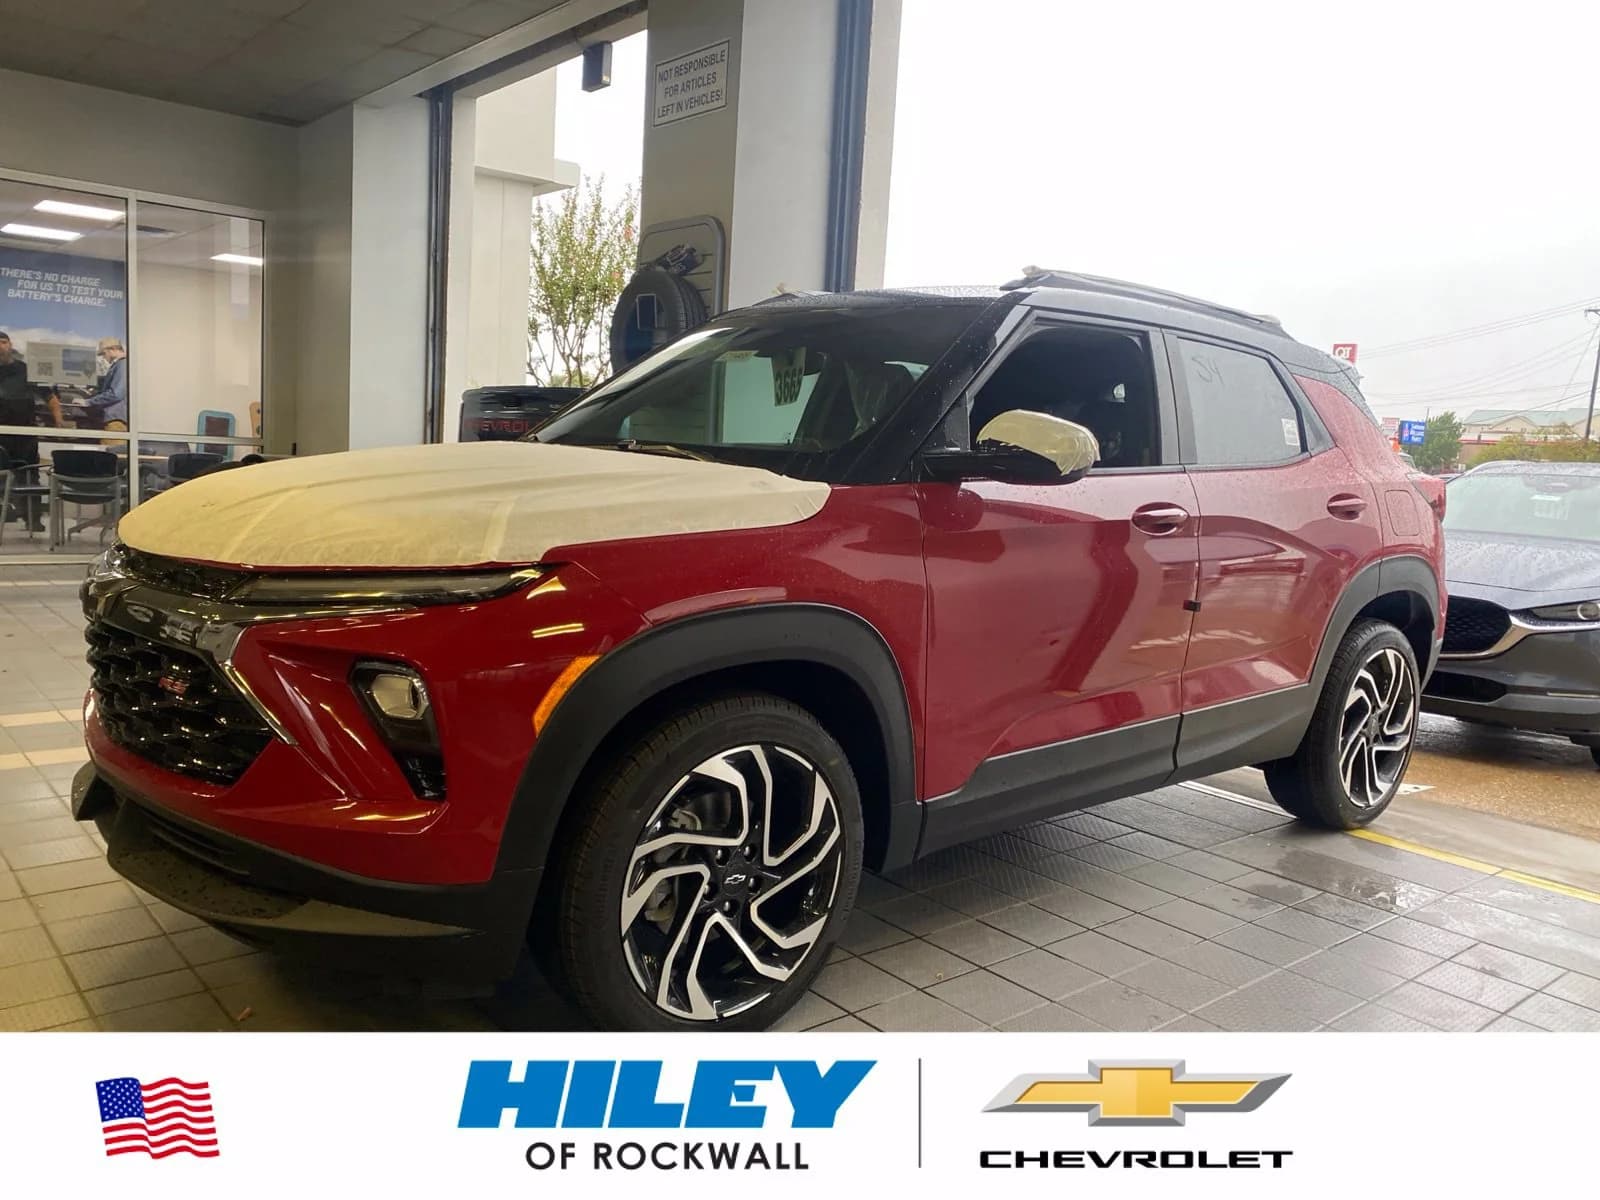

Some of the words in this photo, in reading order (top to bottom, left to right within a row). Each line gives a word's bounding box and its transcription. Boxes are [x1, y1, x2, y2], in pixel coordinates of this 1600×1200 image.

[658, 67, 673, 82] NOT
[674, 50, 726, 78] RESPONSIBLE
[664, 84, 679, 98] FOR
[681, 71, 717, 93] ARTICLES
[657, 103, 674, 118] LEFT
[684, 88, 723, 109] VEHICLES!
[0, 267, 42, 281] THERE'S
[44, 272, 59, 282] NO
[60, 274, 101, 287] CHARGE
[7, 288, 62, 303] BATTERY'S
[63, 294, 107, 307] CHARGE.
[17, 279, 38, 290] FOR
[39, 282, 53, 291] US
[56, 284, 69, 293] TO
[71, 285, 97, 296] TEST
[98, 288, 124, 299] YOUR
[1336, 346, 1353, 359] QT
